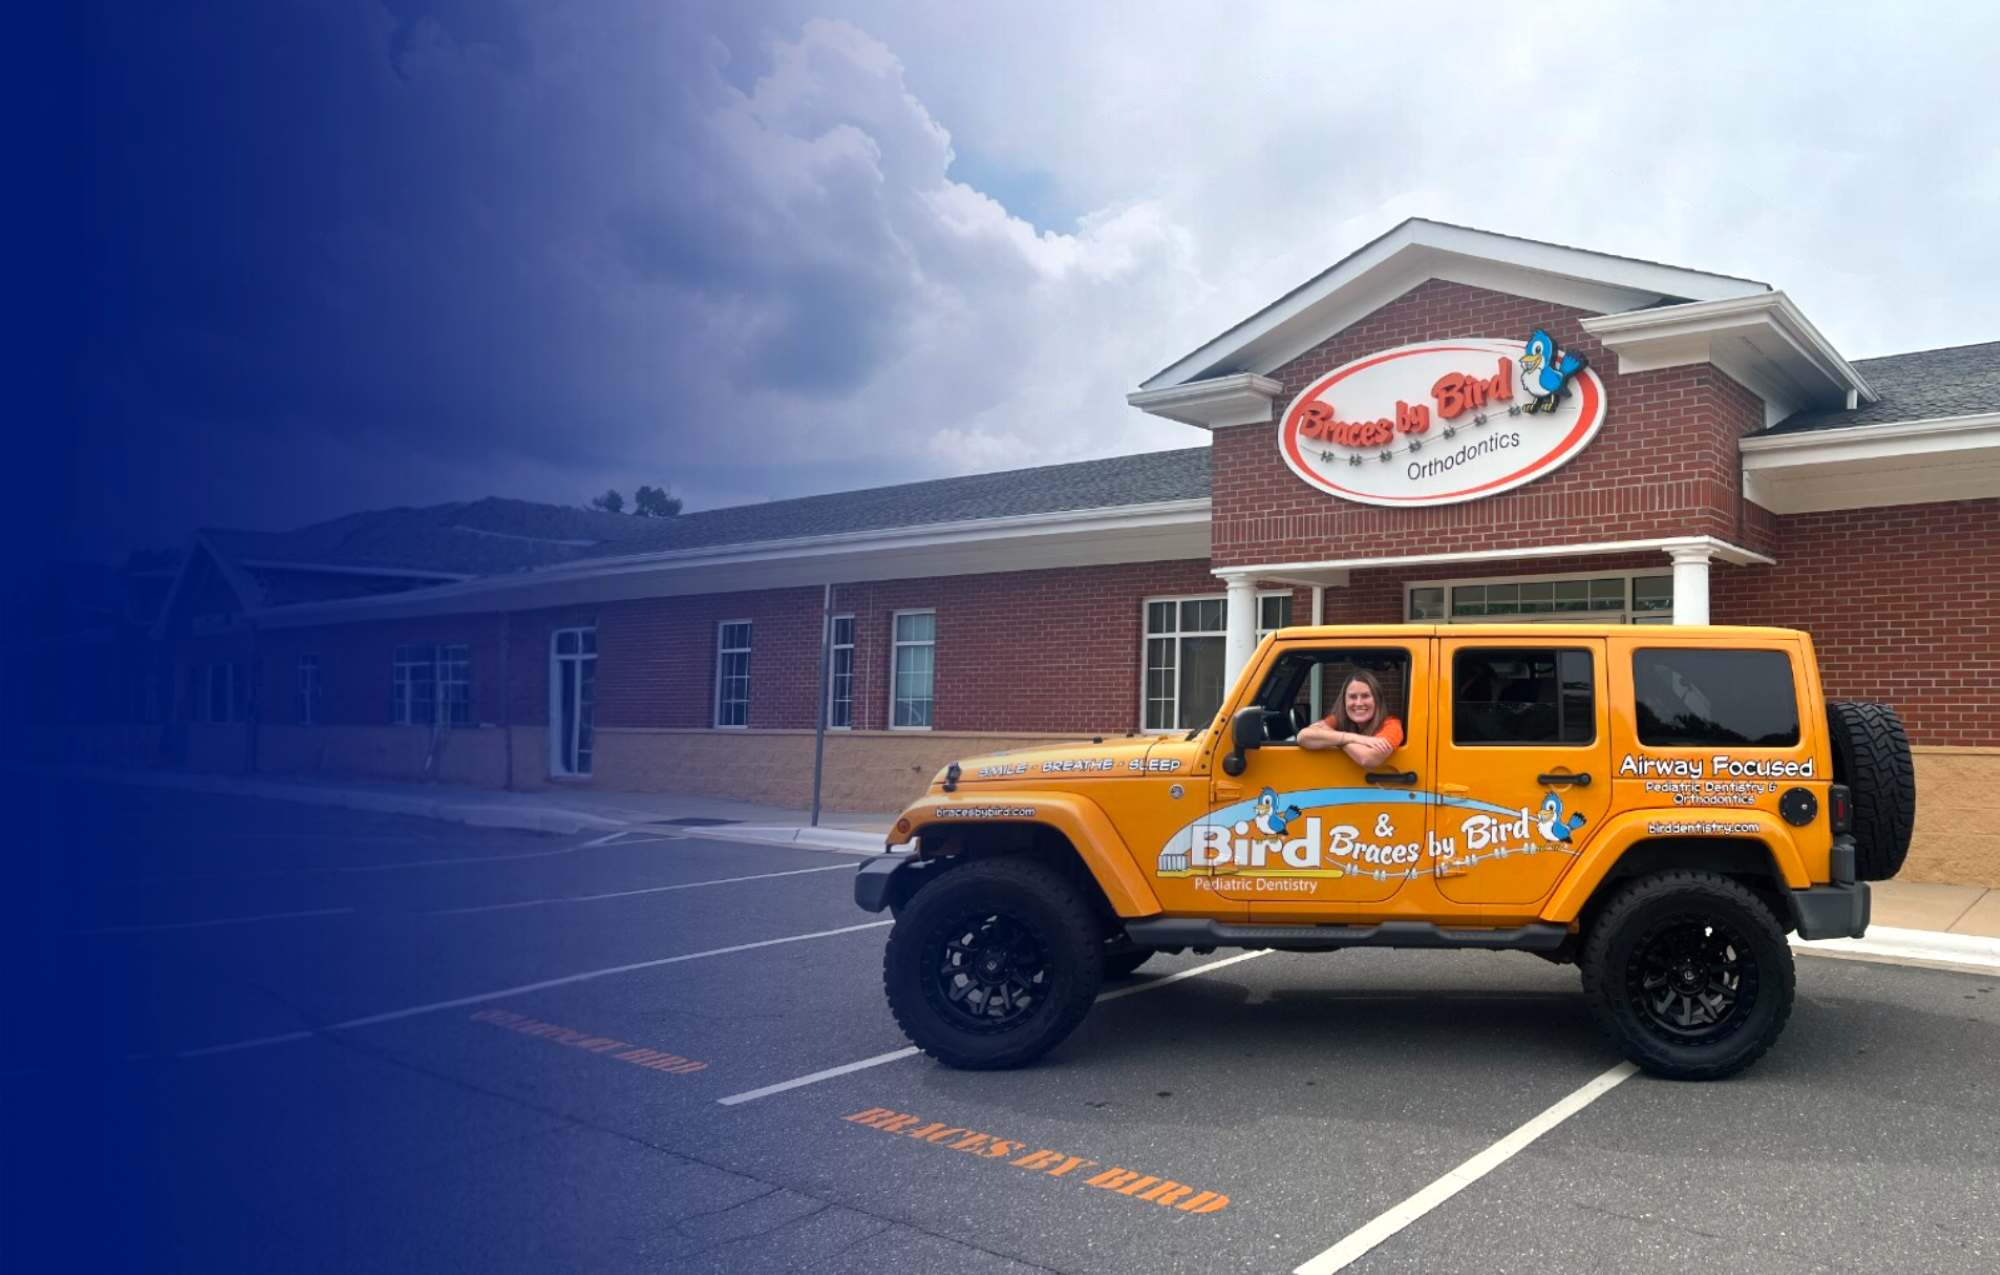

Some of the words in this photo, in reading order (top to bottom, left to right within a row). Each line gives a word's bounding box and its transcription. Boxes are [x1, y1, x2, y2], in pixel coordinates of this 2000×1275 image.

[1299, 400, 1394, 447] Braces
[1396, 400, 1430, 434] by
[1431, 357, 1514, 419] Bird
[1407, 431, 1520, 481] Orthodontics
[978, 763, 1028, 778] SMILE
[1041, 758, 1114, 773] BREATHE
[1128, 758, 1181, 772] SLEEP
[1620, 754, 1703, 778] Airway
[1712, 755, 1814, 777] Focused
[1645, 781, 1701, 793] Pediatric
[1705, 781, 1765, 795] Dentistry
[1768, 781, 1777, 793] &
[1673, 794, 1756, 805] Orthodontics
[935, 806, 1036, 819] bracesbybird.com
[1329, 825, 1419, 865] Braces
[1428, 830, 1455, 860] by
[1461, 808, 1530, 850] Bird
[1374, 813, 1395, 838] &
[1648, 822, 1760, 835] birddentistry.com
[1191, 816, 1321, 868] Bird
[1195, 876, 1252, 891] Pediatric
[1256, 877, 1318, 894] Dentistry
[842, 1107, 1027, 1159] BRACES
[1008, 1149, 1098, 1176] BY
[1084, 1166, 1231, 1213] BIRD
